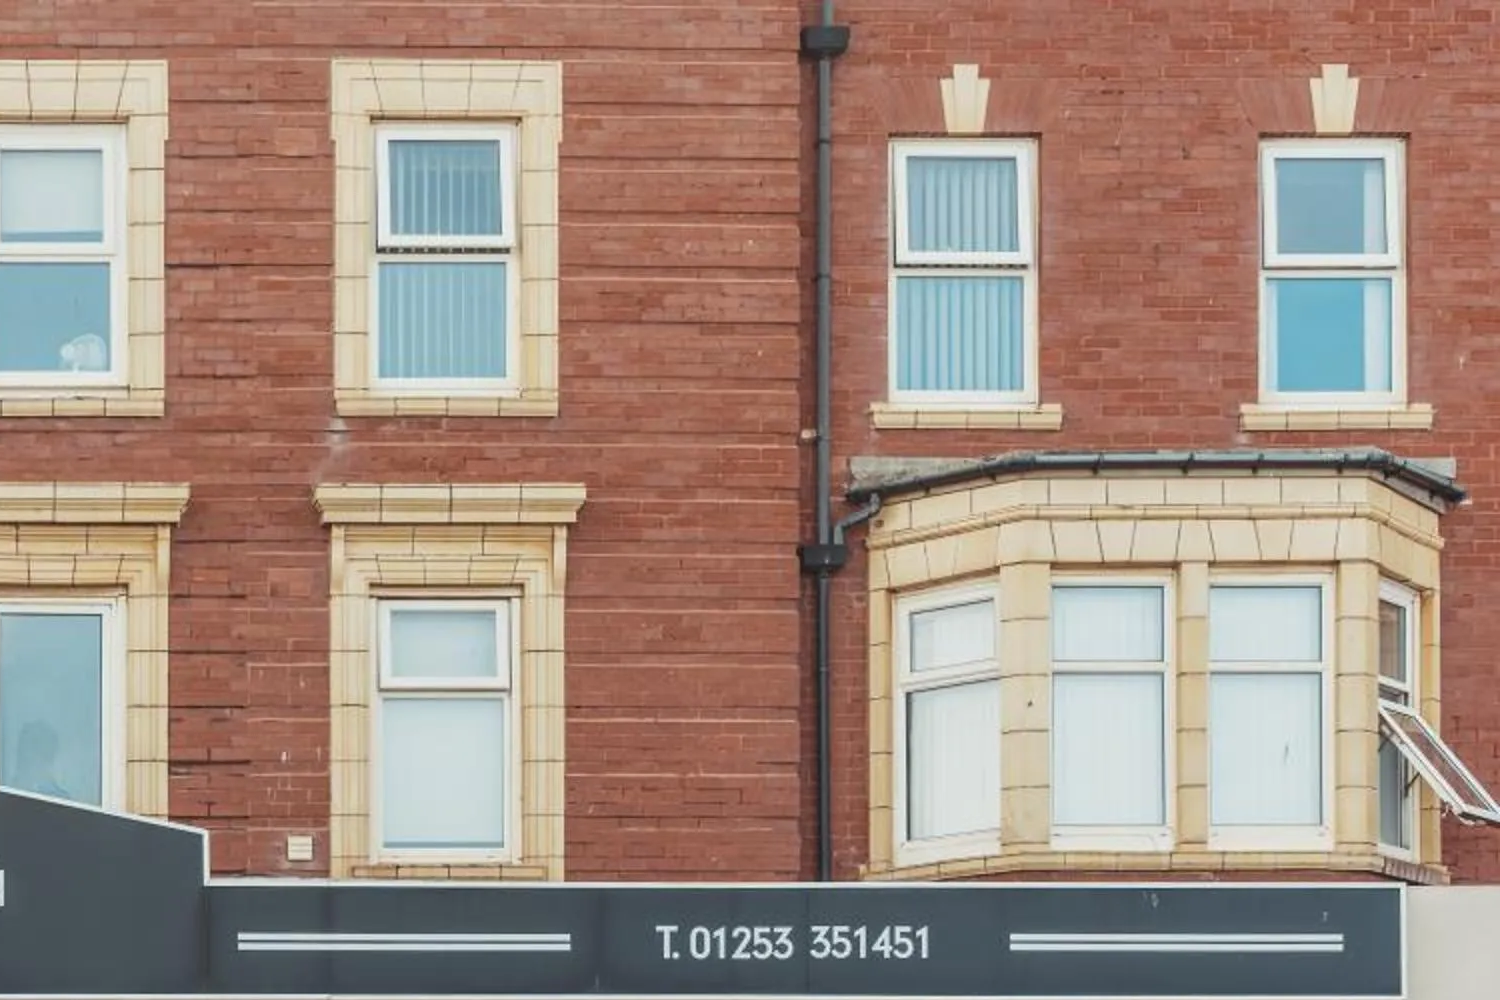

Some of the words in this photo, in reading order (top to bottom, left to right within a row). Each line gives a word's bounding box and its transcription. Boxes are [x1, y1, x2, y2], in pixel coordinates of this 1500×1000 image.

[655, 925, 680, 960] T.
[689, 925, 794, 960] 01253
[809, 925, 929, 959] 351451
